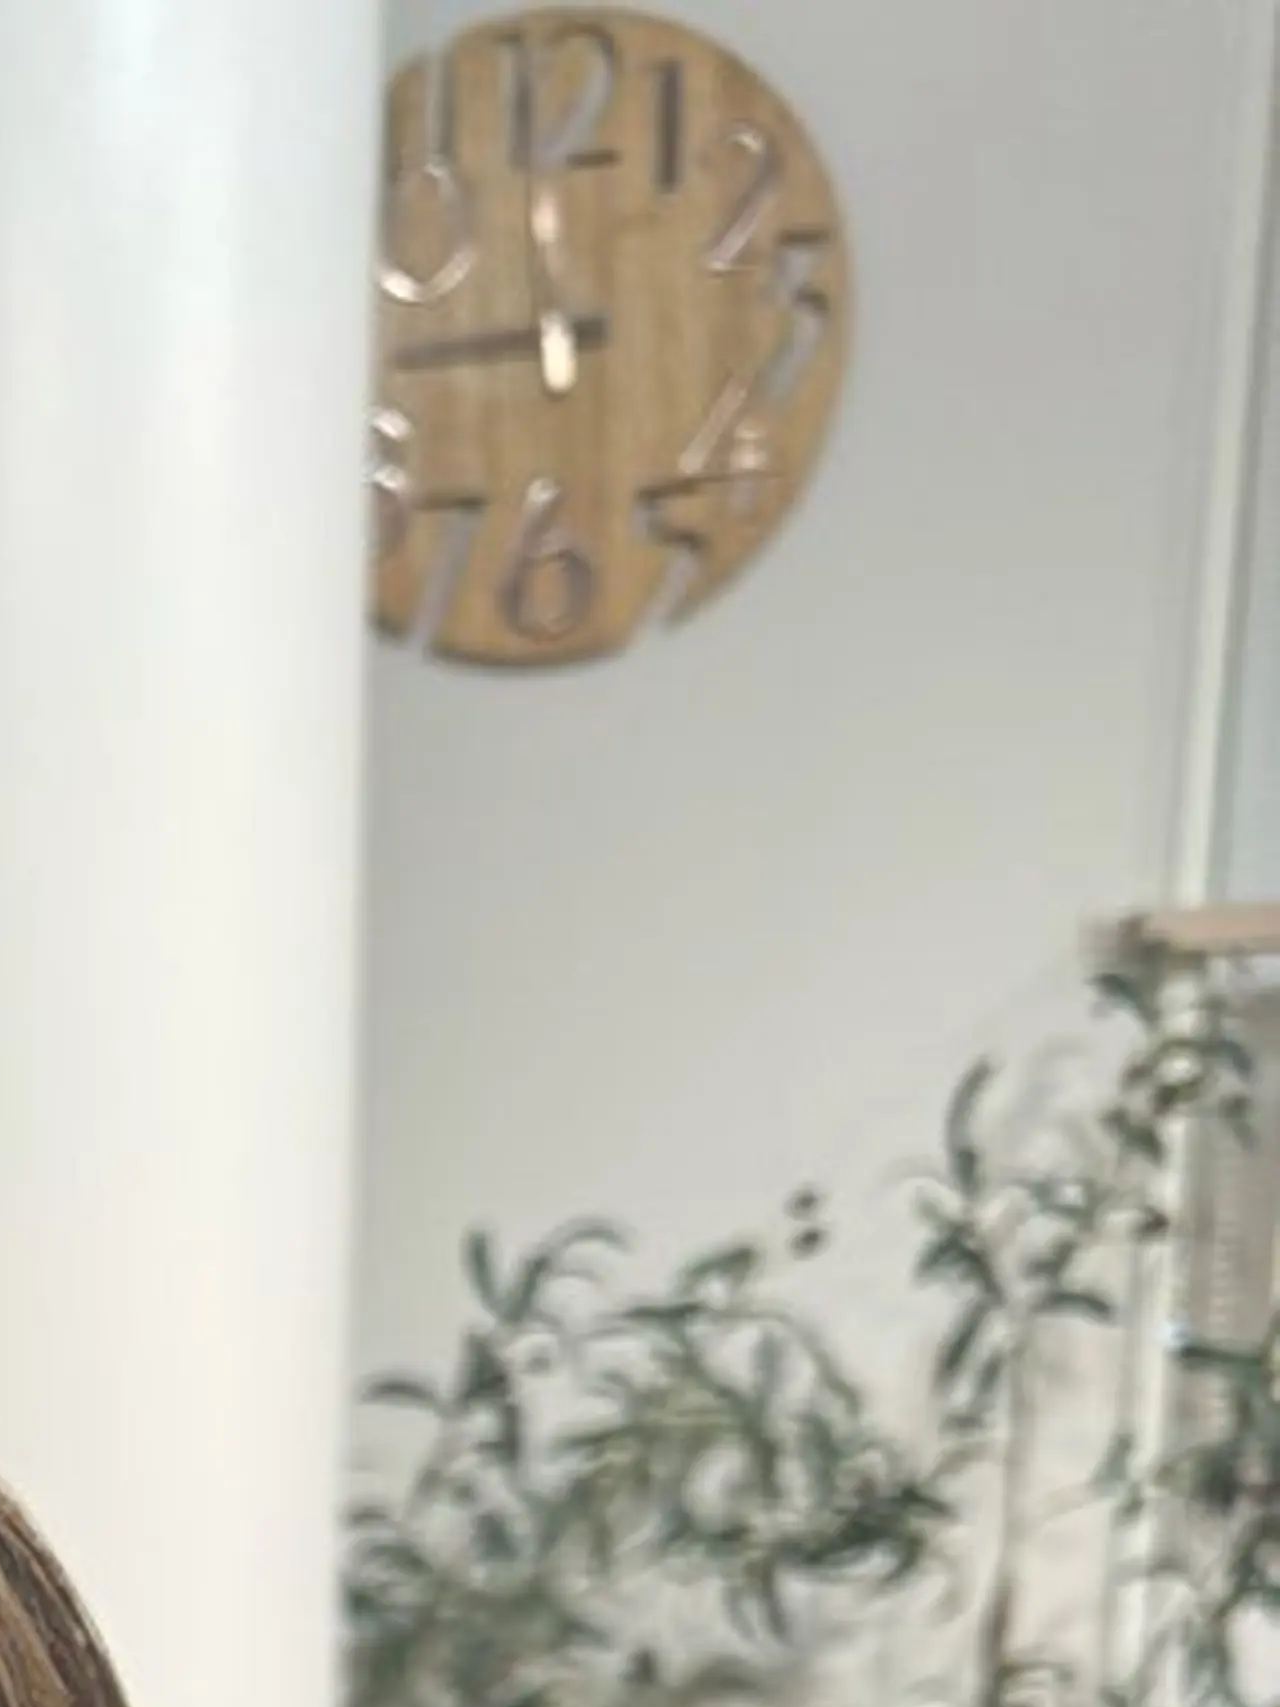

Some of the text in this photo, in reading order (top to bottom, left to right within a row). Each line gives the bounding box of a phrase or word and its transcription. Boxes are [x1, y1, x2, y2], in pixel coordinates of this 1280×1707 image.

[496, 22, 622, 172] 12
[651, 58, 685, 195] 1
[698, 120, 783, 277] 2
[765, 225, 831, 405] 3
[678, 368, 785, 515] 4
[408, 492, 490, 655] 7
[498, 475, 597, 643] 6
[632, 480, 710, 622] 5
